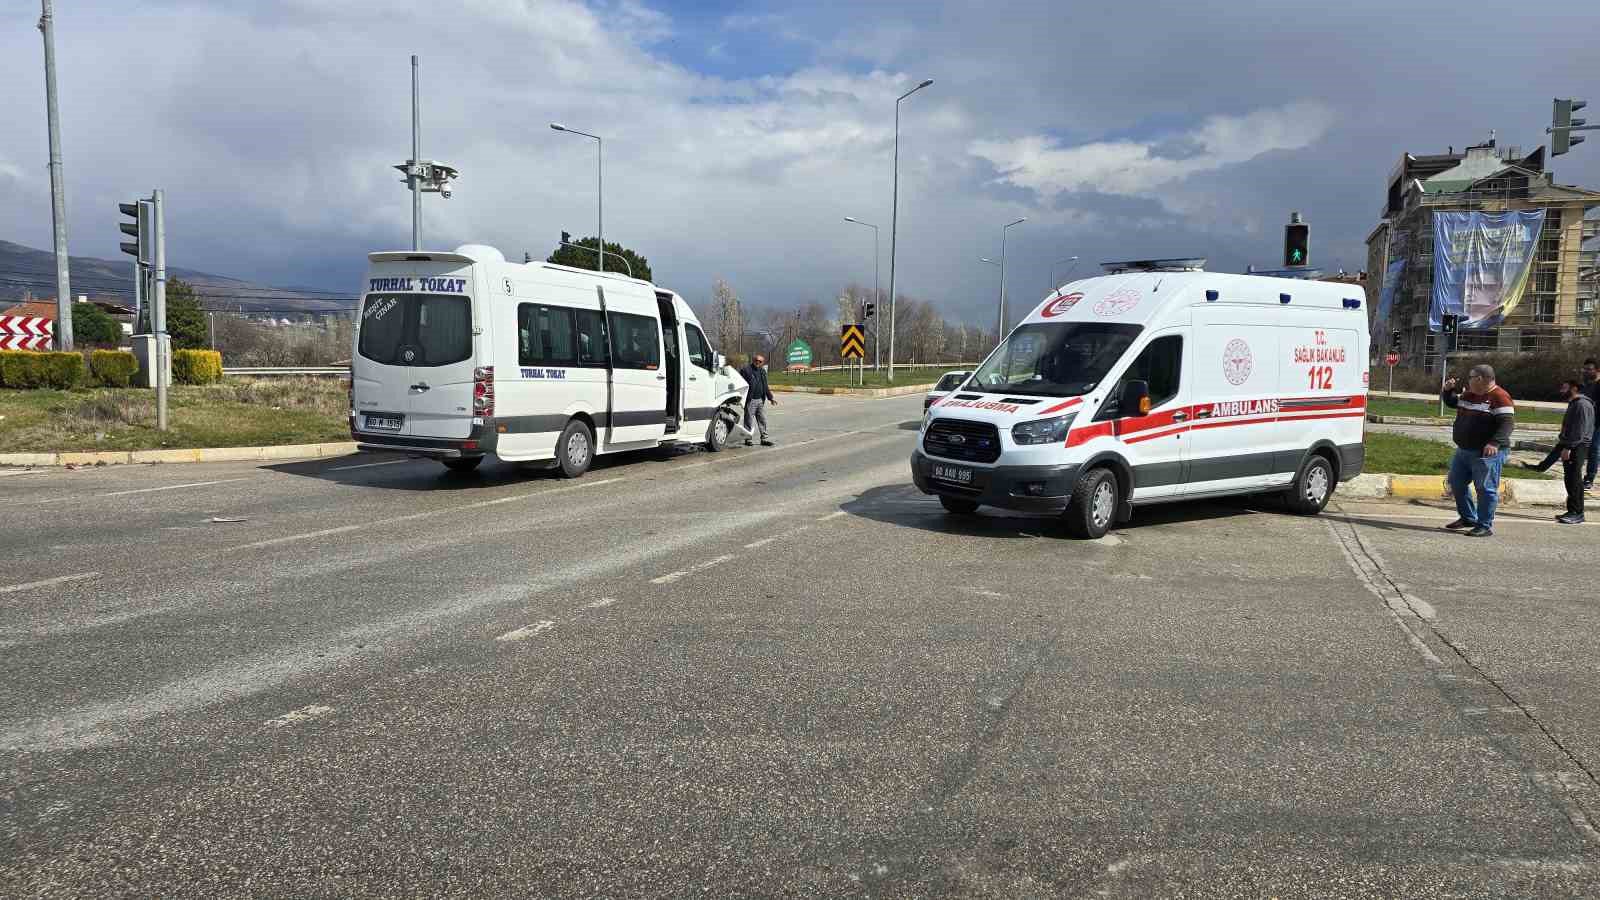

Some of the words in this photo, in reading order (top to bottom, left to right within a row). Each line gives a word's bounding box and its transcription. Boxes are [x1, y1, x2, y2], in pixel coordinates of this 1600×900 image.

[370, 278, 413, 291] TURHAL
[420, 278, 466, 292] TOKAT
[505, 280, 511, 293] 5
[520, 368, 544, 379] TURHAL
[545, 369, 566, 379] TOKAT
[1308, 366, 1333, 390] 112
[1211, 398, 1279, 417] AMBULANS
